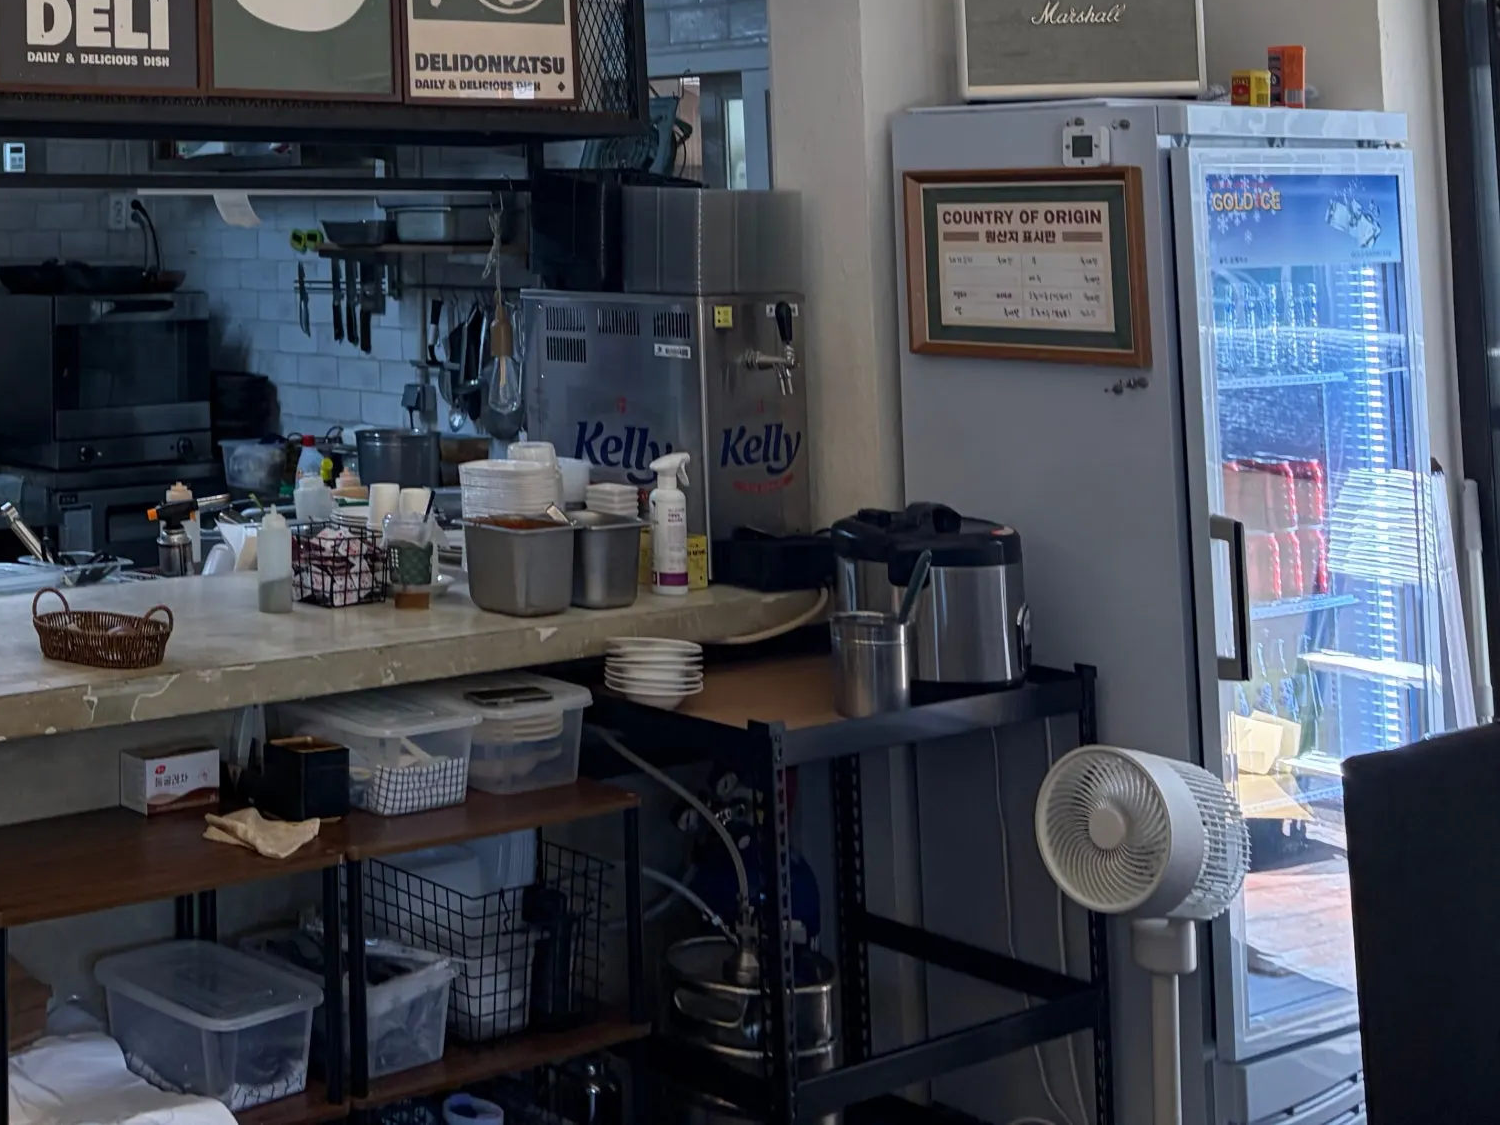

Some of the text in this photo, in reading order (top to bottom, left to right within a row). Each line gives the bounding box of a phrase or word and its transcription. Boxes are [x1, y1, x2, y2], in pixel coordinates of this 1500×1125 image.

[1031, 0, 1127, 26] Marshall
[27, 51, 170, 68] DAILY & DELICIOUS DISH
[415, 52, 565, 75] DELIDONKATSU
[415, 79, 446, 90] DAILY
[449, 79, 457, 91] &
[460, 80, 514, 92] DELICIOUS
[1212, 191, 1253, 212] GOLD
[942, 209, 1102, 225] COUNTRY OF ORIGIN
[985, 230, 1057, 244] 원산지 표시판
[574, 421, 673, 485] Kelly
[720, 422, 802, 475] Kelly
